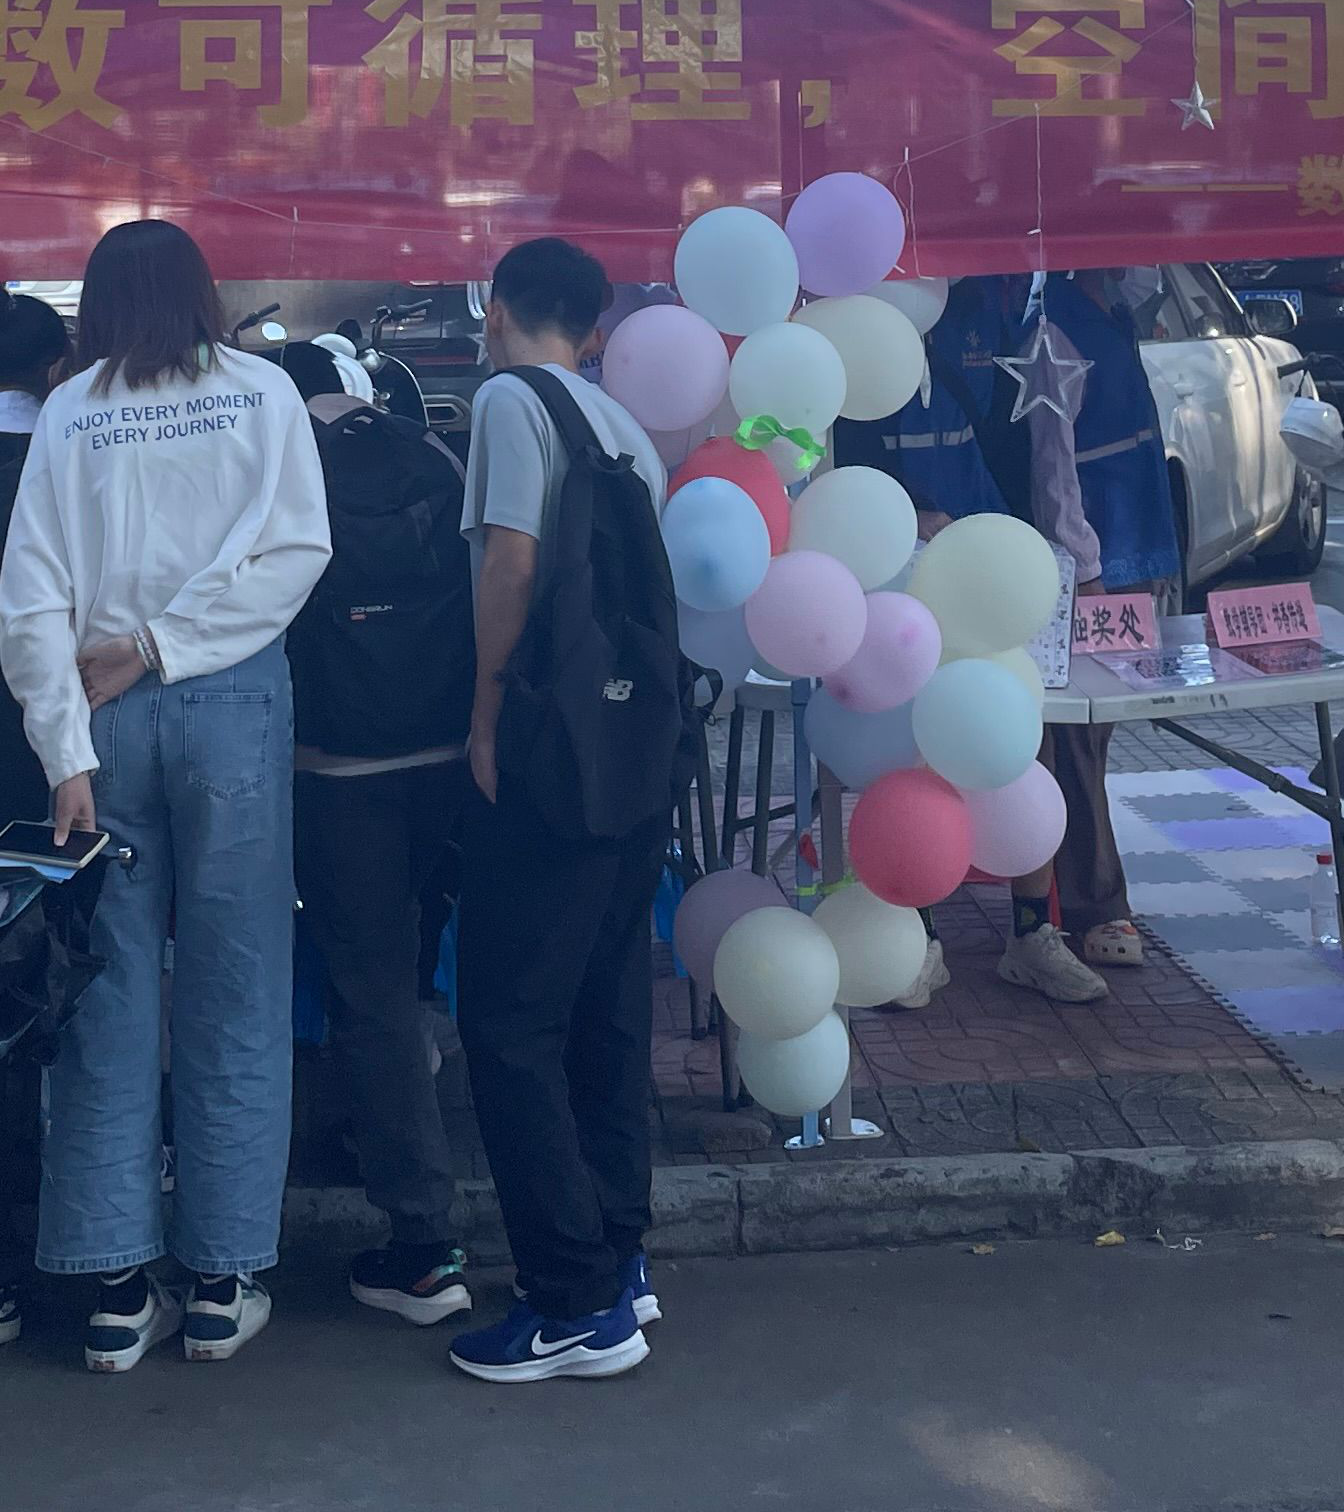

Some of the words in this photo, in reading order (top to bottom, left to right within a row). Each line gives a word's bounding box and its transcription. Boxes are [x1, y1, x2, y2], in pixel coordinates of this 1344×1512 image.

[65, 409, 114, 439] ENJOY
[121, 404, 180, 422] EVERY
[186, 392, 265, 415] MOMENT
[92, 426, 150, 450] EVERY
[155, 414, 238, 441] JOURNEY
